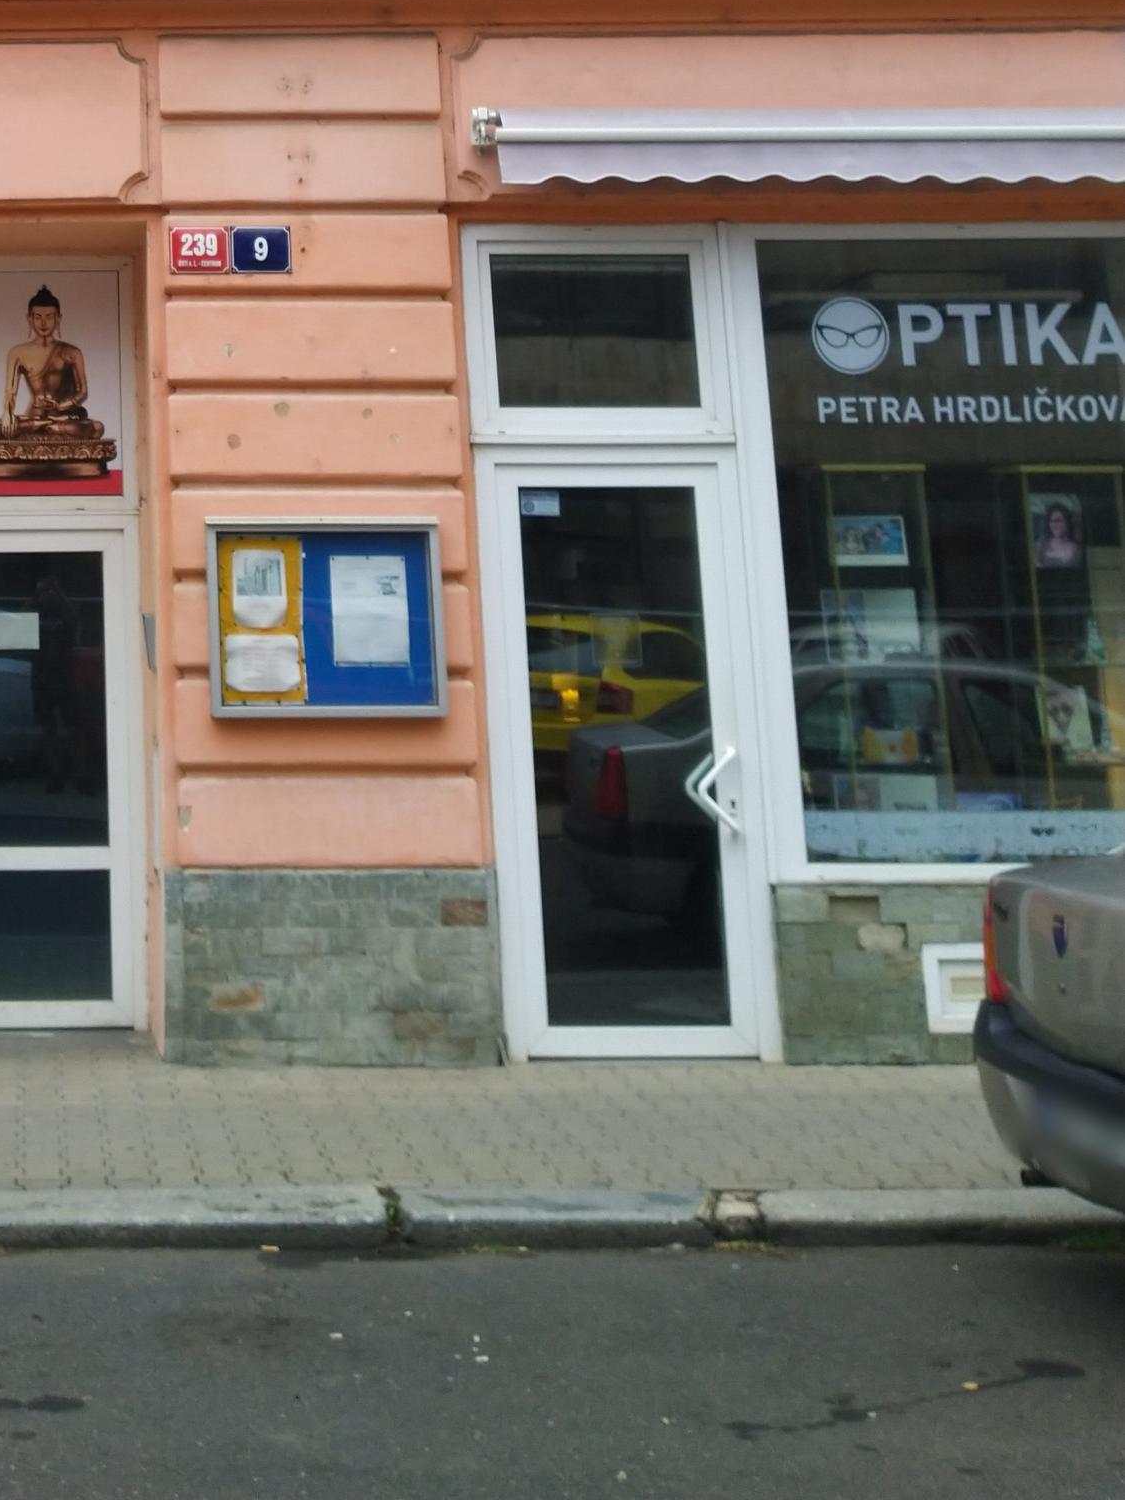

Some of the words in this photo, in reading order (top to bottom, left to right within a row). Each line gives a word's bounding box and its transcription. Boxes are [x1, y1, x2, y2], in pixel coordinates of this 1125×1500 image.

[180, 233, 218, 257] 239
[253, 236, 269, 262] 9
[817, 395, 925, 424] PETRA
[932, 386, 1125, 423] HRDLIČKOV
